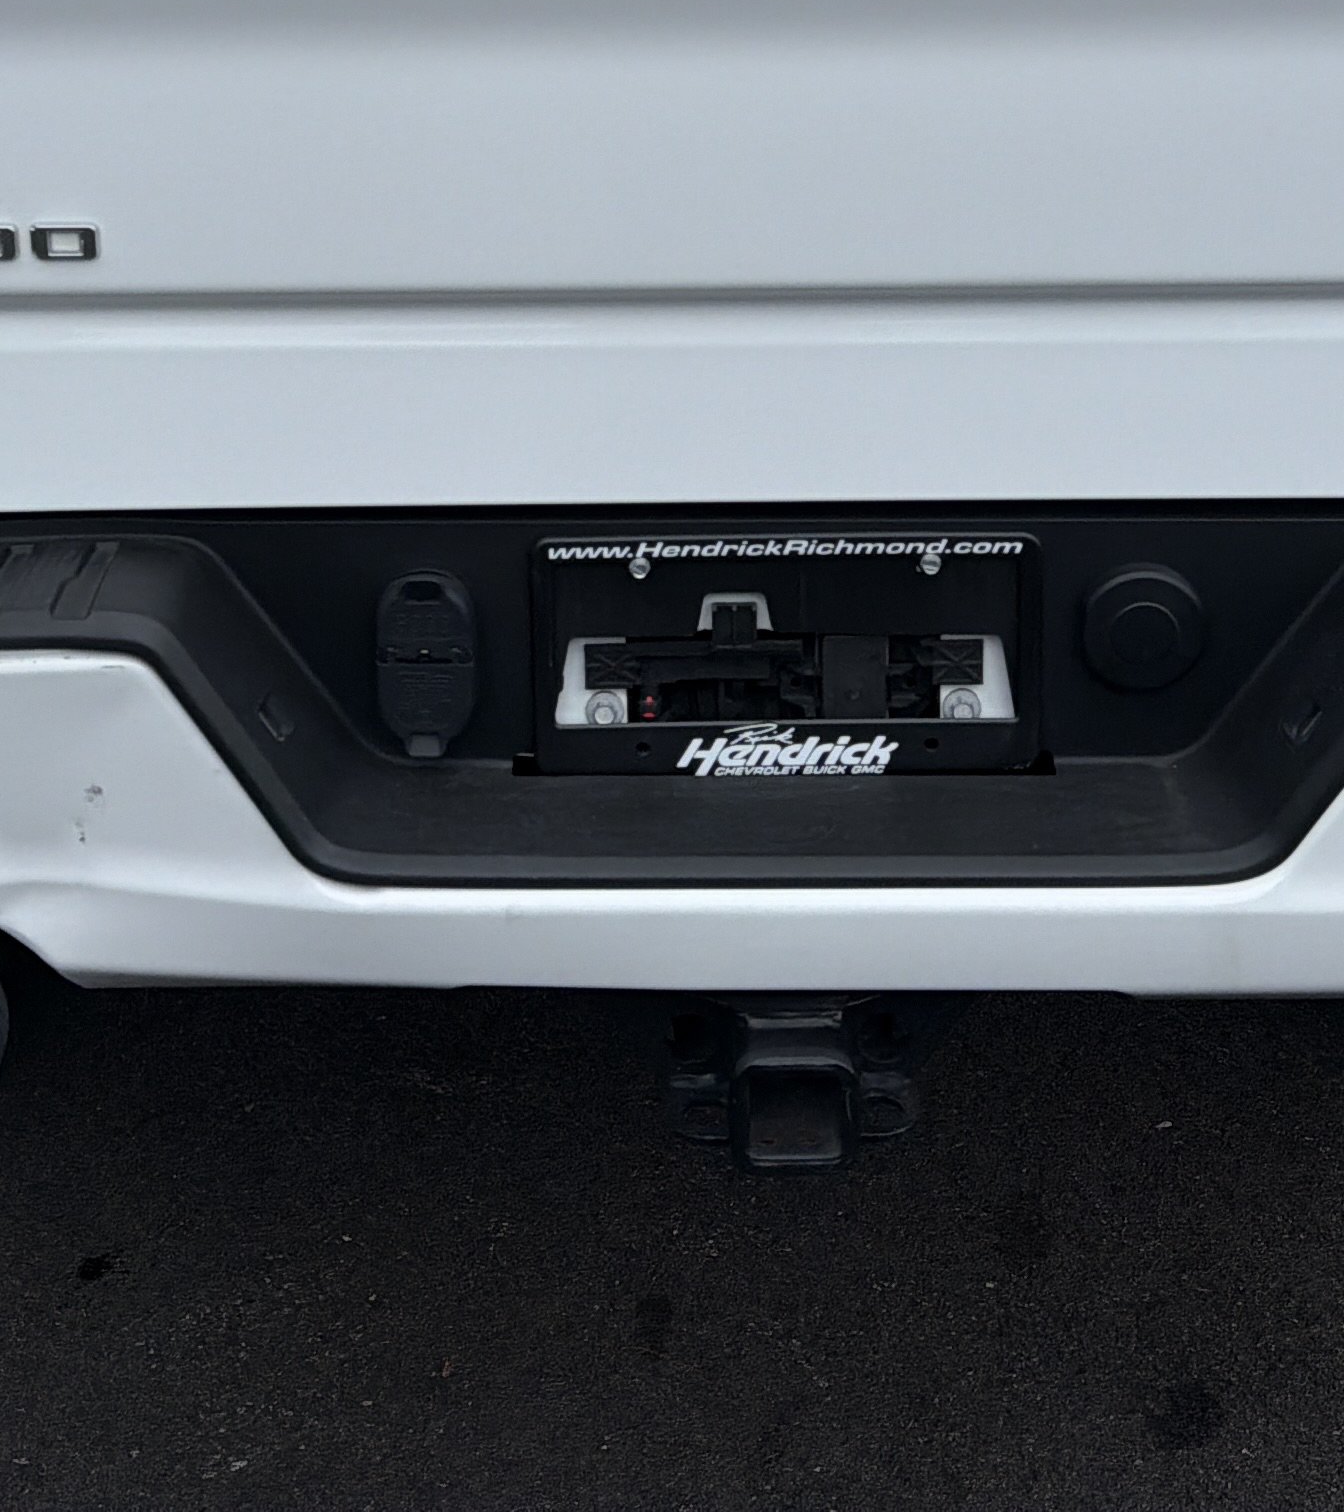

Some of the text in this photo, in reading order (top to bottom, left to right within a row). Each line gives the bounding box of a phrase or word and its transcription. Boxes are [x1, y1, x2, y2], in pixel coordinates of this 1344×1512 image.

[547, 539, 1024, 560] www.HendrickRichmond.com
[675, 735, 900, 777] Hendrick
[713, 764, 886, 777] CHEVROLET BUICK GMC
